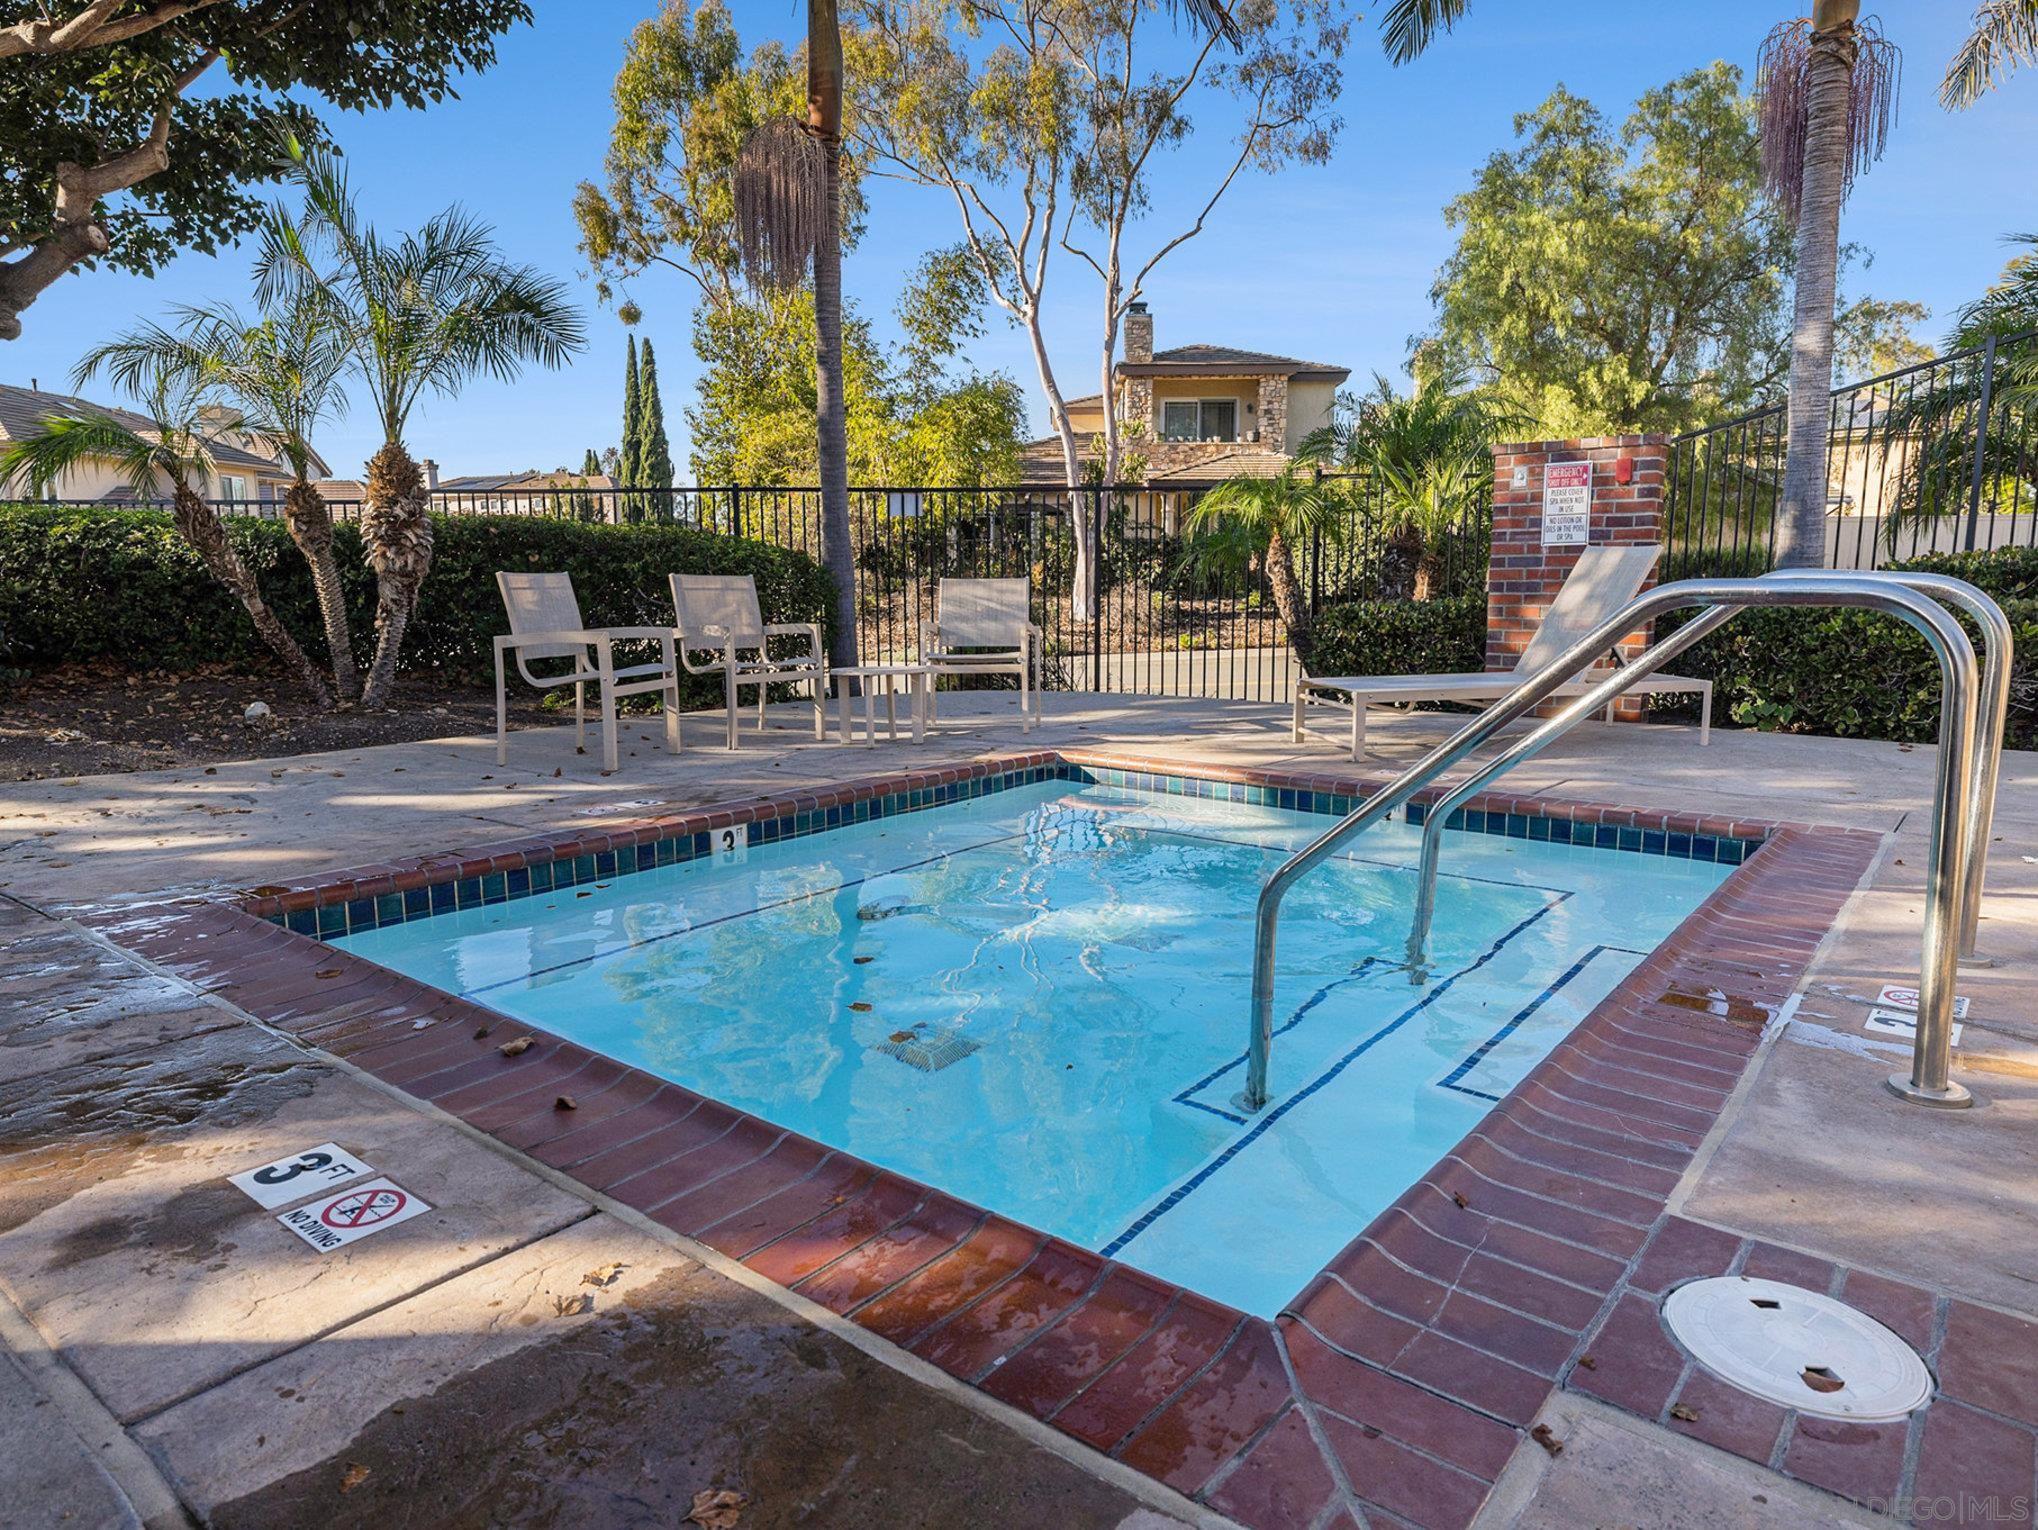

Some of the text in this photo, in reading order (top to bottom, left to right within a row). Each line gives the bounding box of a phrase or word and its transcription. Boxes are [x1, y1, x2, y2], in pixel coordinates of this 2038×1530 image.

[1548, 467, 1584, 478] EMERGENCY
[1548, 477, 1583, 487] SHUT OFF ONLY
[1574, 496, 1584, 504] NOT
[1549, 516, 1582, 524] NO LOTION OR
[1546, 525, 1556, 533] OILS
[1573, 524, 1585, 532] POOL
[736, 827, 743, 837] FT
[253, 1153, 356, 1184] 3 FT
[285, 1210, 342, 1247] NO DIVING
